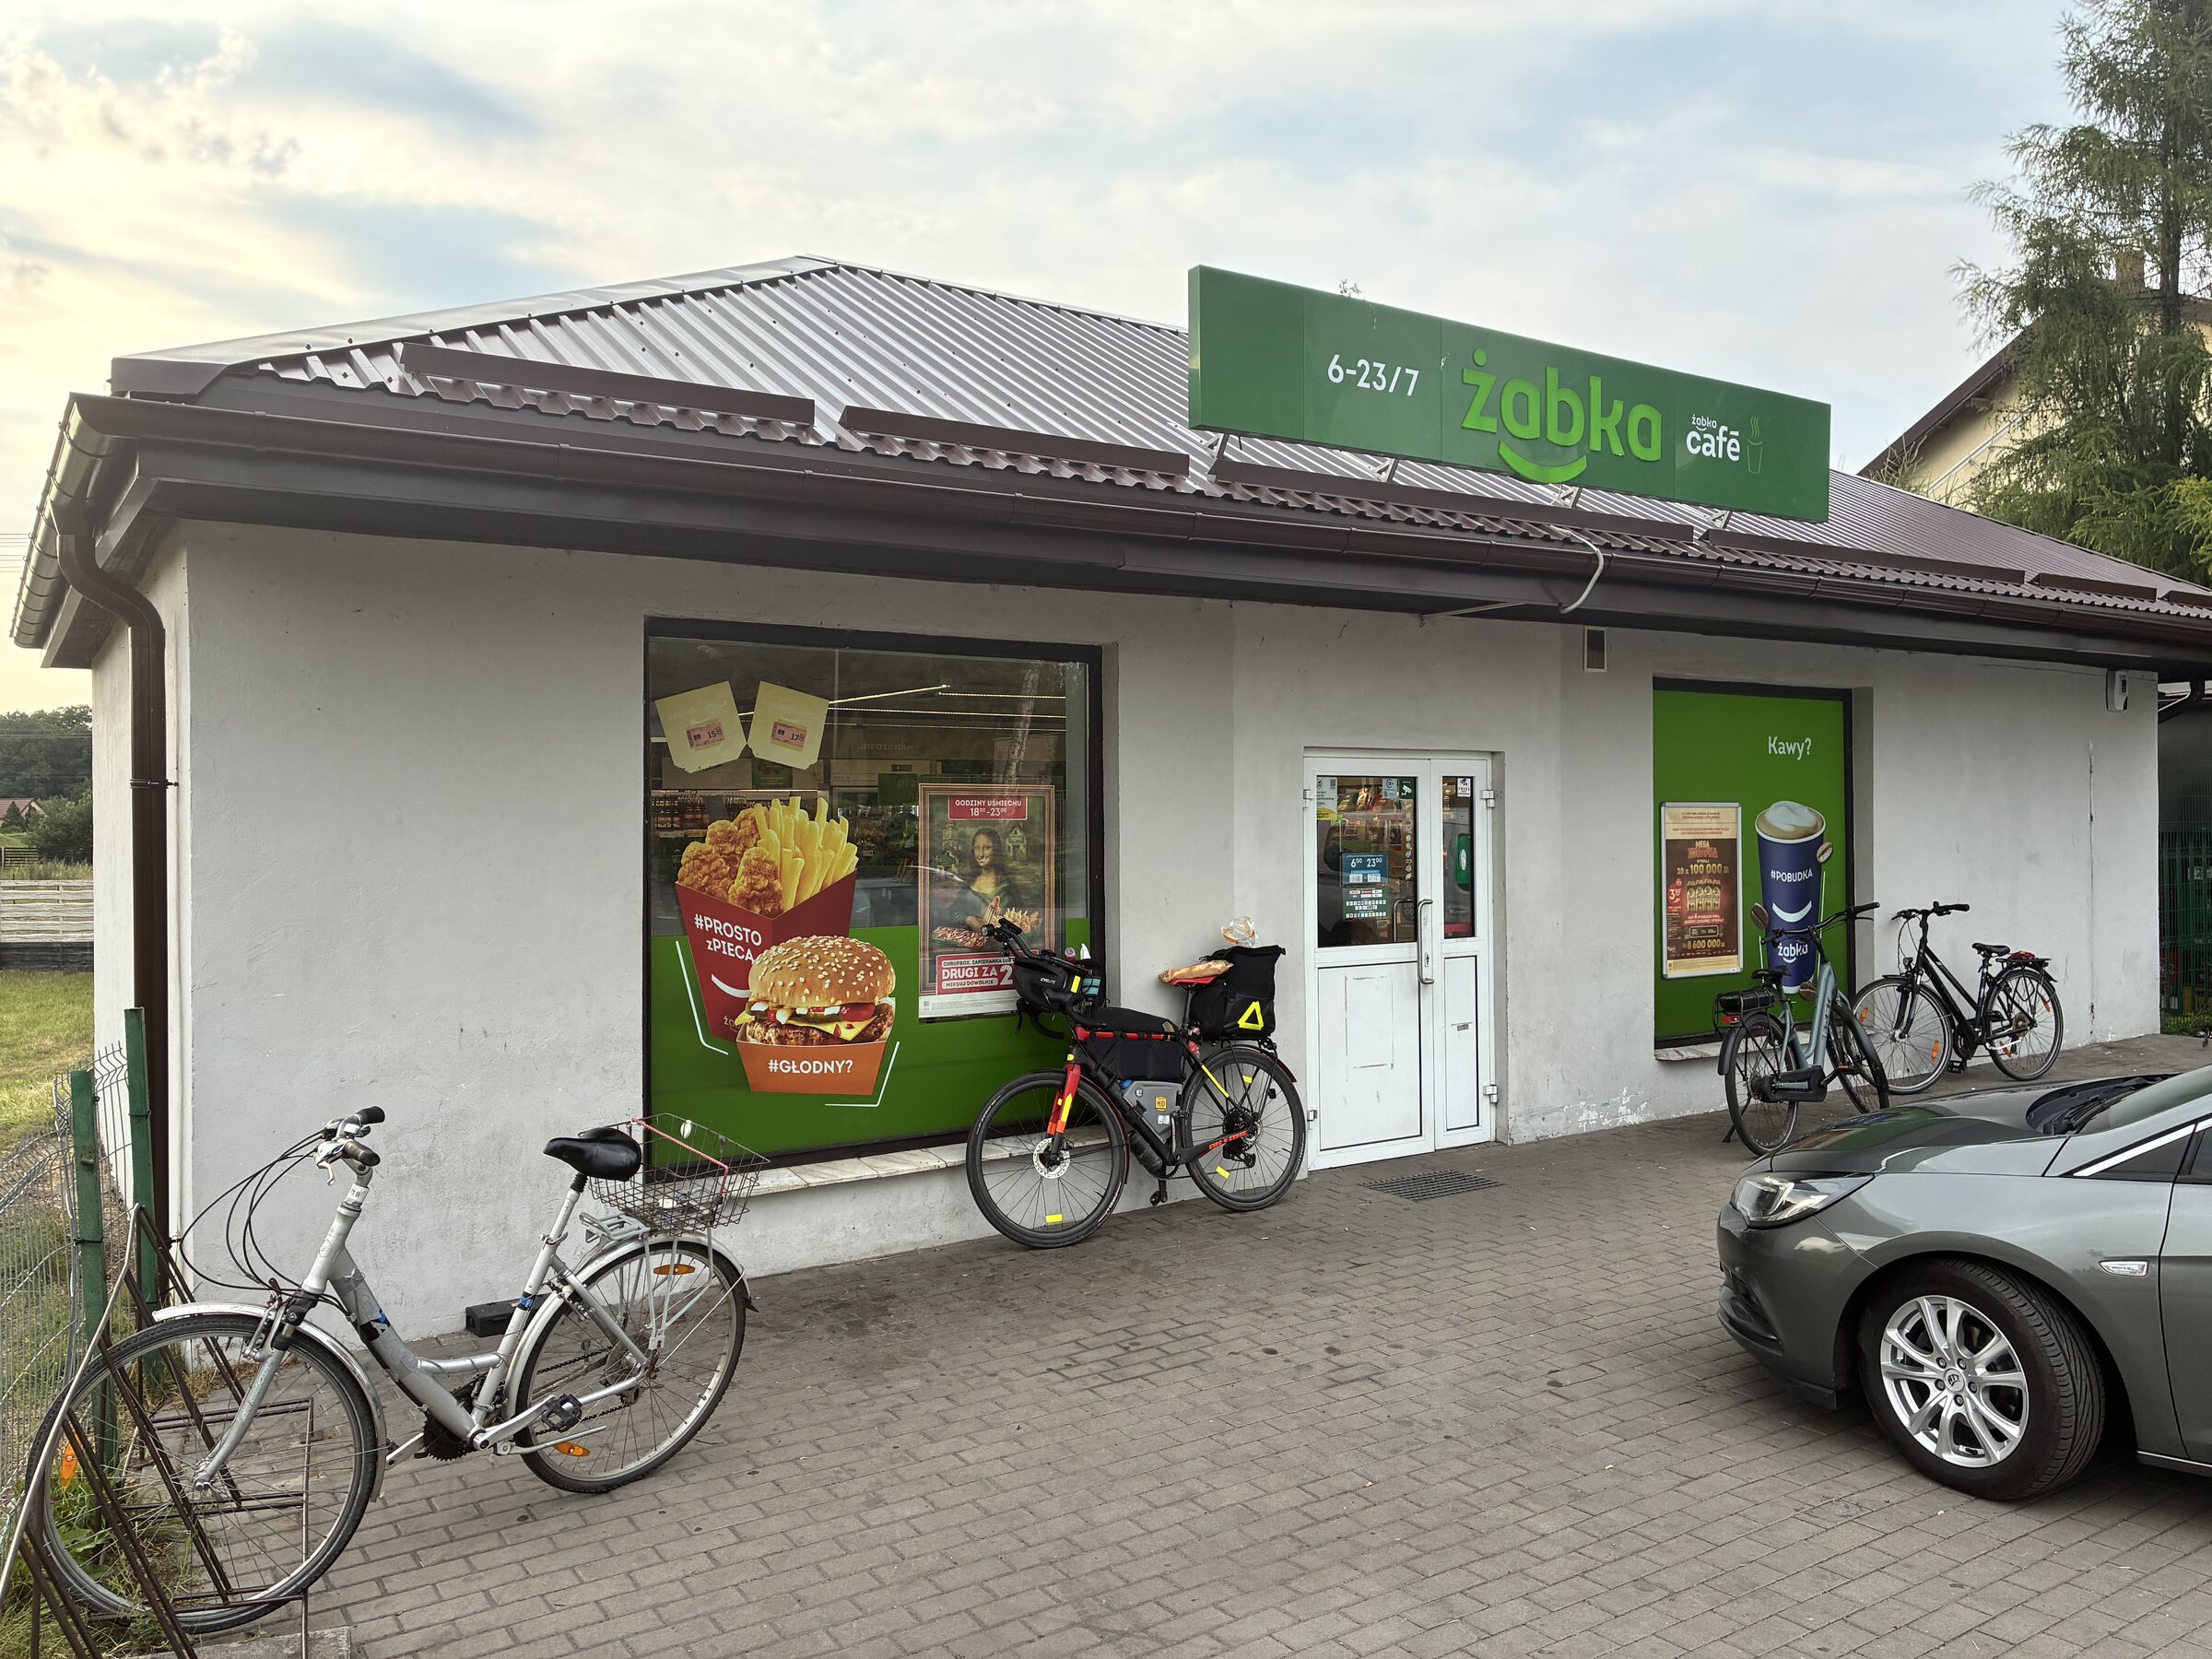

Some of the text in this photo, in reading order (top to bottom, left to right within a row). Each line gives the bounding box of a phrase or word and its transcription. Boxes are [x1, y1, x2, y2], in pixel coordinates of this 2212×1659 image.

[1327, 354, 1419, 396] 6-23/7
[1461, 348, 1662, 462] żabka
[1691, 414, 1717, 429] żabka
[1768, 735, 1813, 761] Kawy?
[987, 798, 1022, 806] UŚMIECHU
[1689, 864, 1704, 875] 100
[1705, 863, 1723, 874] 000
[1770, 867, 1814, 882] #POBUDKA
[694, 913, 762, 947] #PROSTO
[1707, 938, 1721, 947] 000
[1777, 942, 1808, 958] żabka
[706, 937, 755, 965] zPIECA
[942, 964, 1013, 985] DRUGI ZA 2
[768, 1059, 853, 1074] #GŁODNY?
